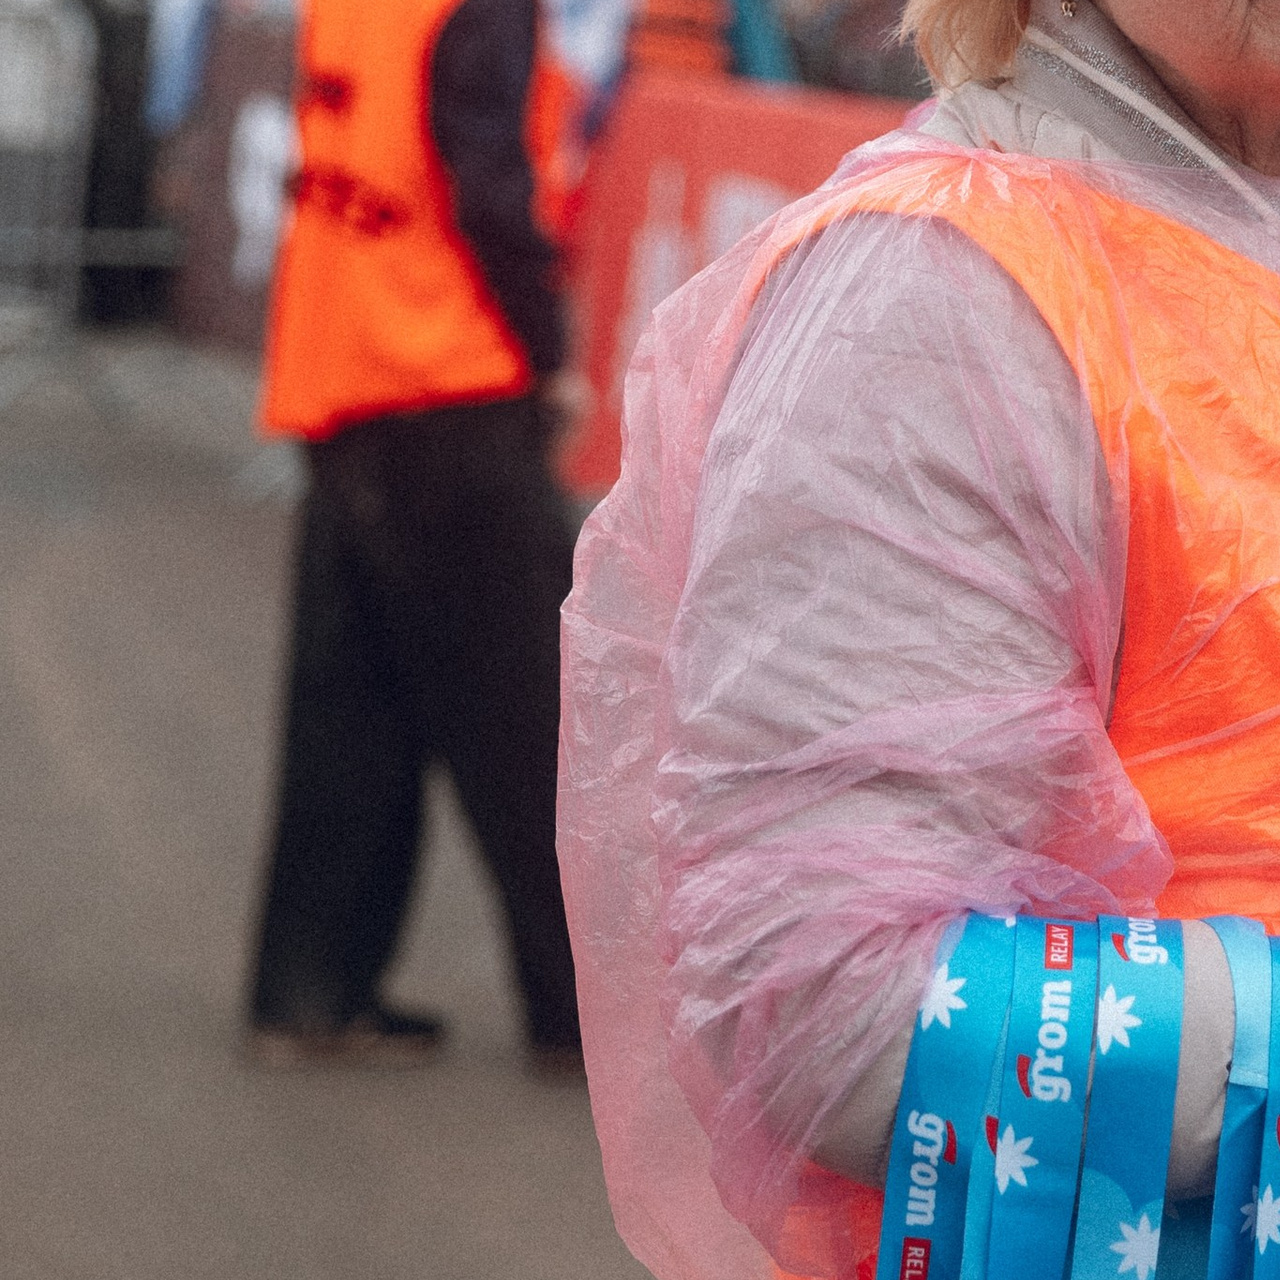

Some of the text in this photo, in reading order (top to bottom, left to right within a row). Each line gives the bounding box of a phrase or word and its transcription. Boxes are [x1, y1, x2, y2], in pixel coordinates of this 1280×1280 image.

[1031, 925, 1073, 1103] grom RELAY
[906, 1109, 946, 1226] grom
